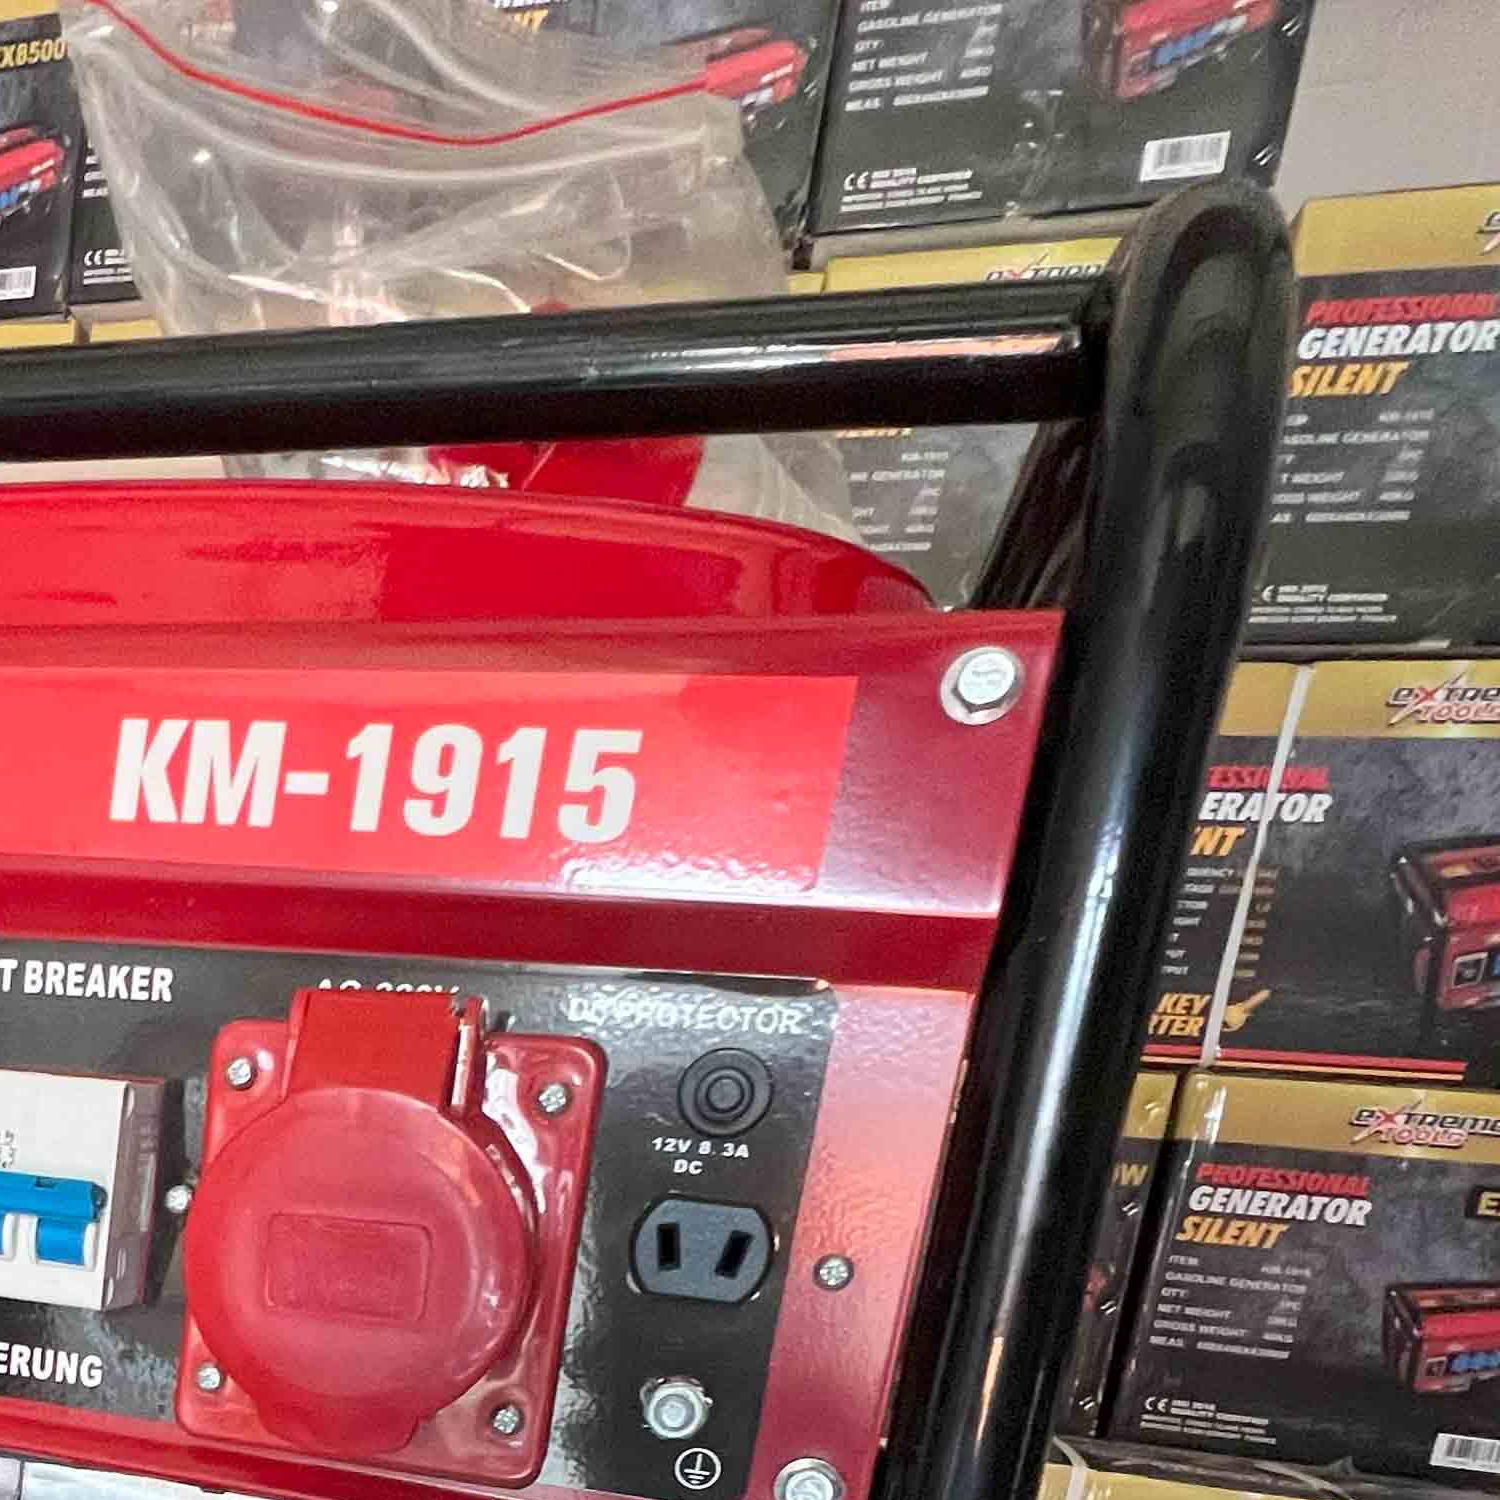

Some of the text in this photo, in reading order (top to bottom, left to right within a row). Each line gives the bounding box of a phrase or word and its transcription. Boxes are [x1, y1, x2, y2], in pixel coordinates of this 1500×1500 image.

[1305, 292, 1497, 326] PROFESSIONAL
[1297, 319, 1500, 360] GENERATOR
[1288, 361, 1411, 399] SILENT
[110, 717, 643, 844] KM-1915
[1199, 791, 1333, 823] ERATOR
[22, 960, 174, 1002] BREAKER
[615, 1001, 807, 1035] PROTECTOR
[651, 1137, 692, 1155] 12V
[672, 1159, 703, 1175] DC
[1196, 1162, 1370, 1197] PROFESSIONAL
[1188, 1185, 1373, 1227] GENERATOR
[1175, 1215, 1291, 1249] SILENT
